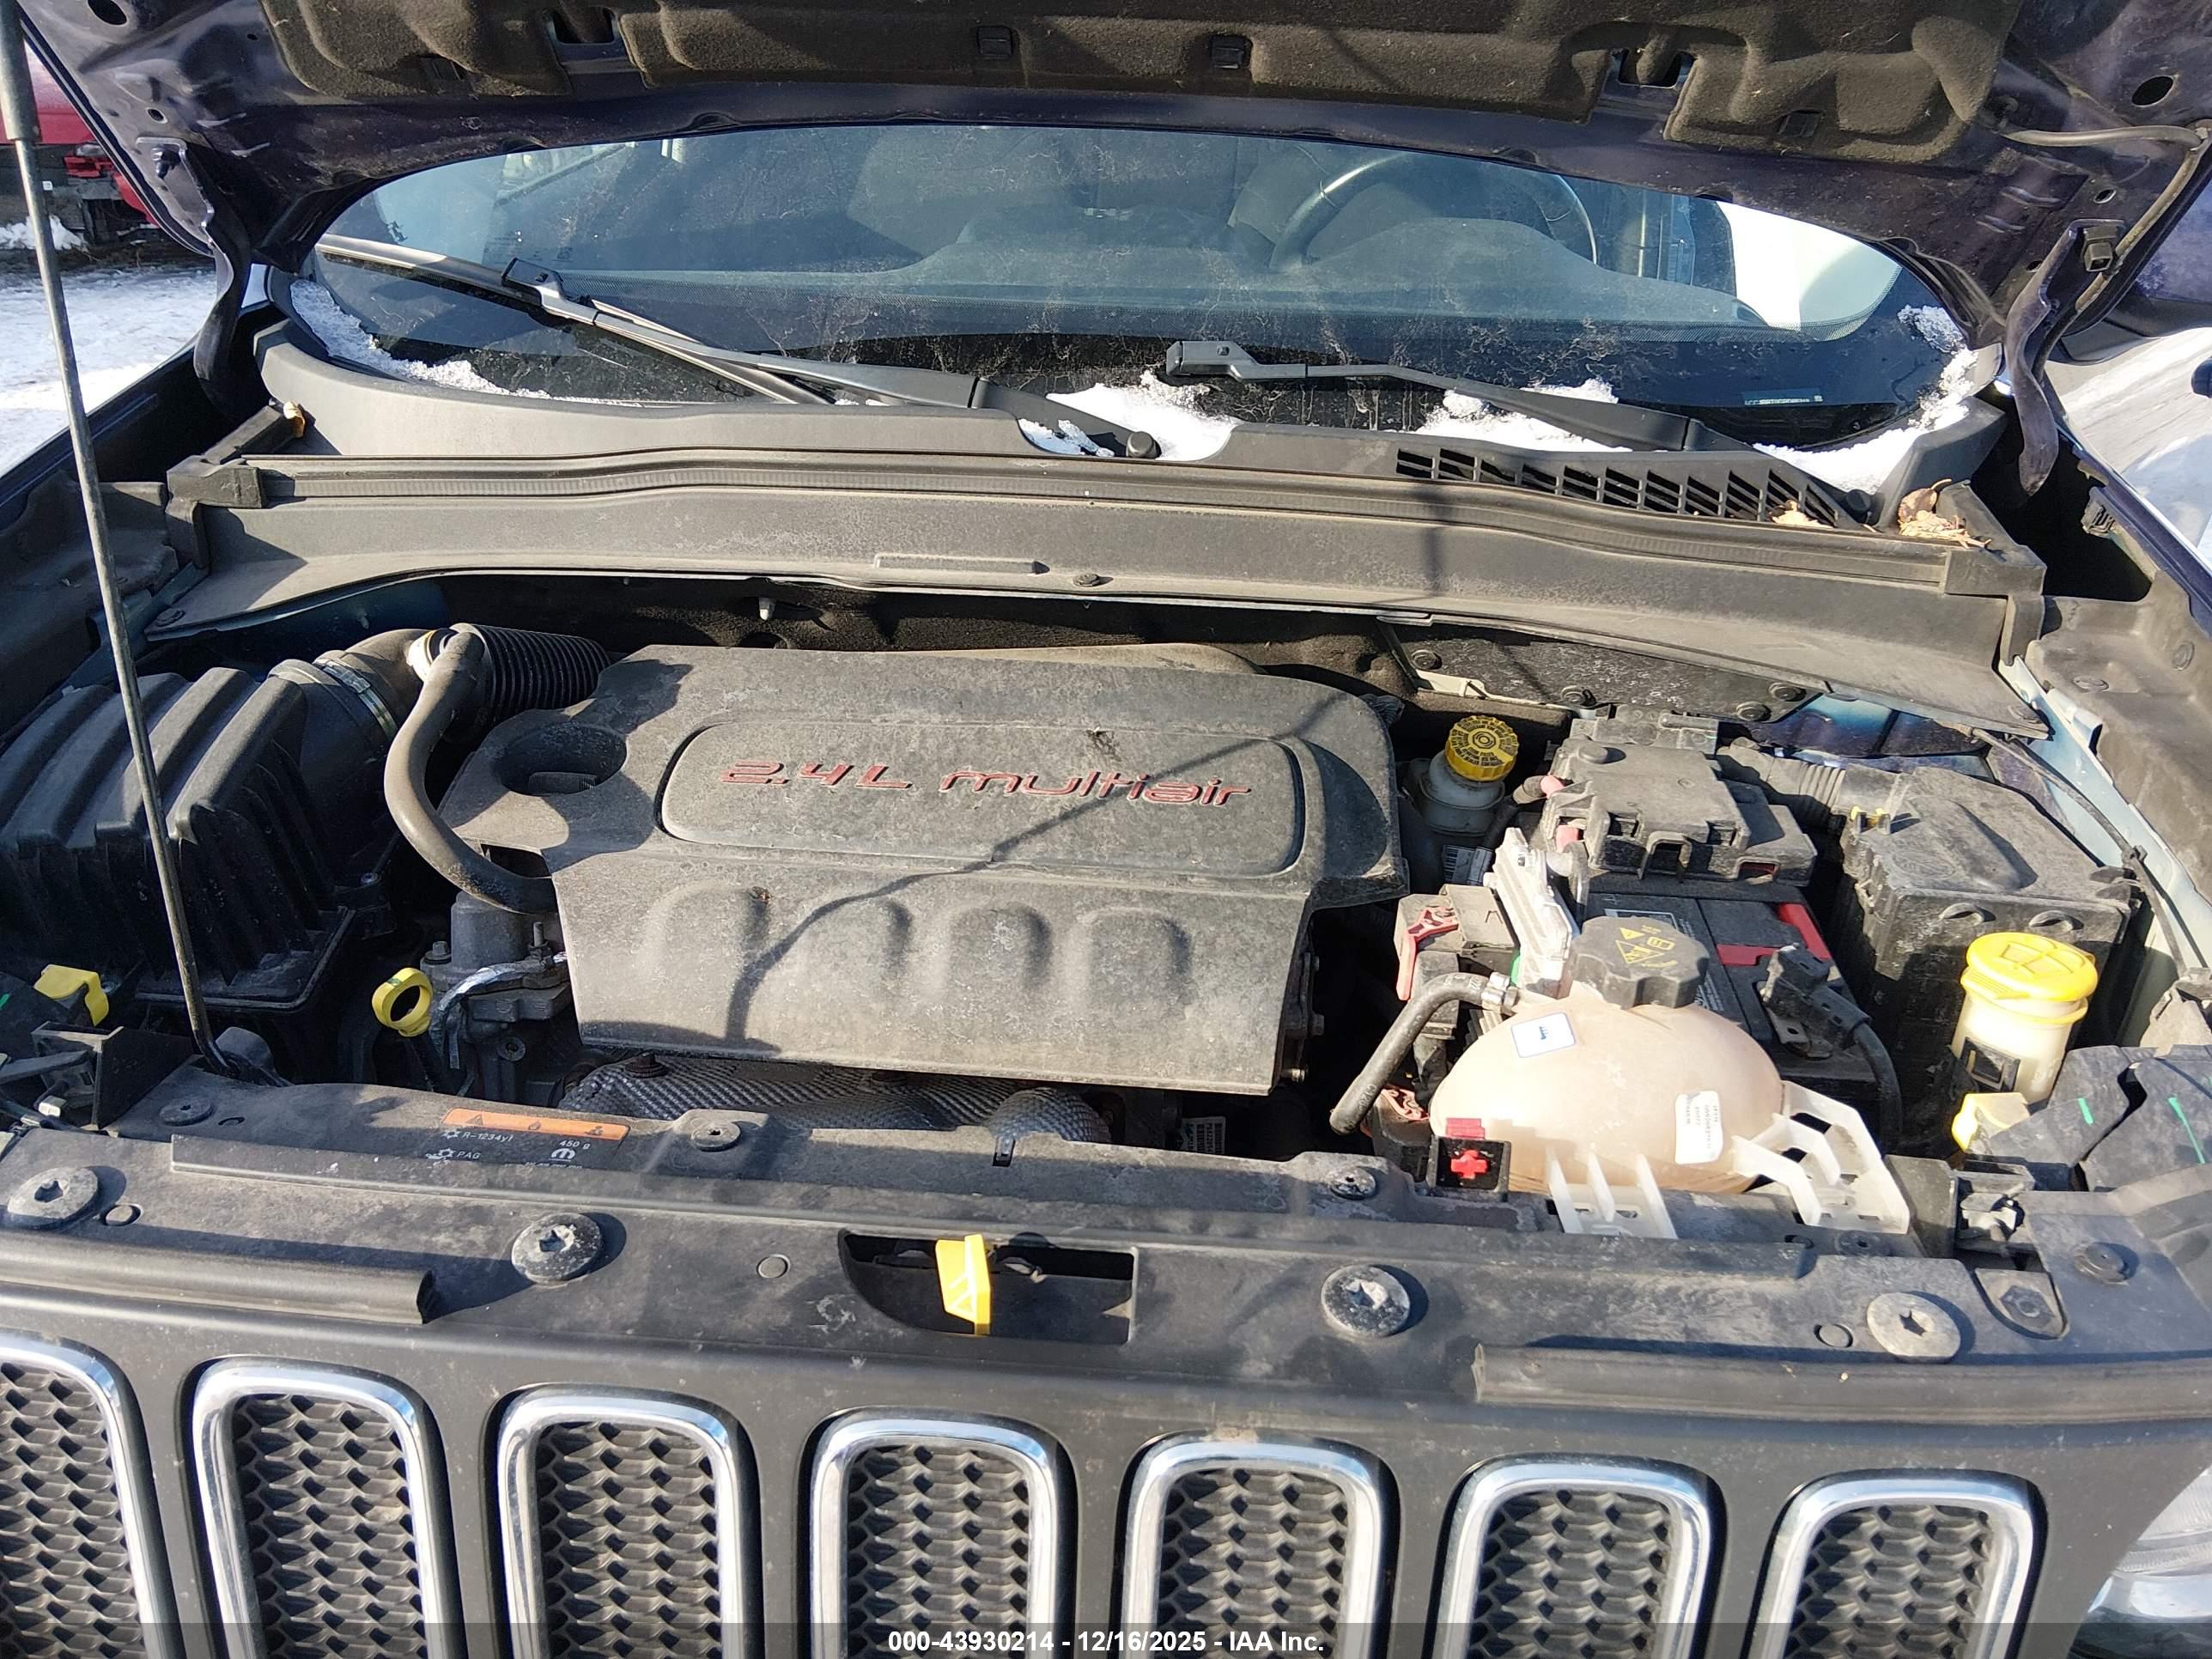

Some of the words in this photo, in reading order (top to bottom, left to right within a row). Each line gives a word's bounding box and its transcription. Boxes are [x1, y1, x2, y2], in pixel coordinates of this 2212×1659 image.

[720, 761, 911, 788] 2.4L
[939, 769, 1252, 805] multiair
[559, 1139, 580, 1148] 450
[457, 1151, 482, 1159] PAG
